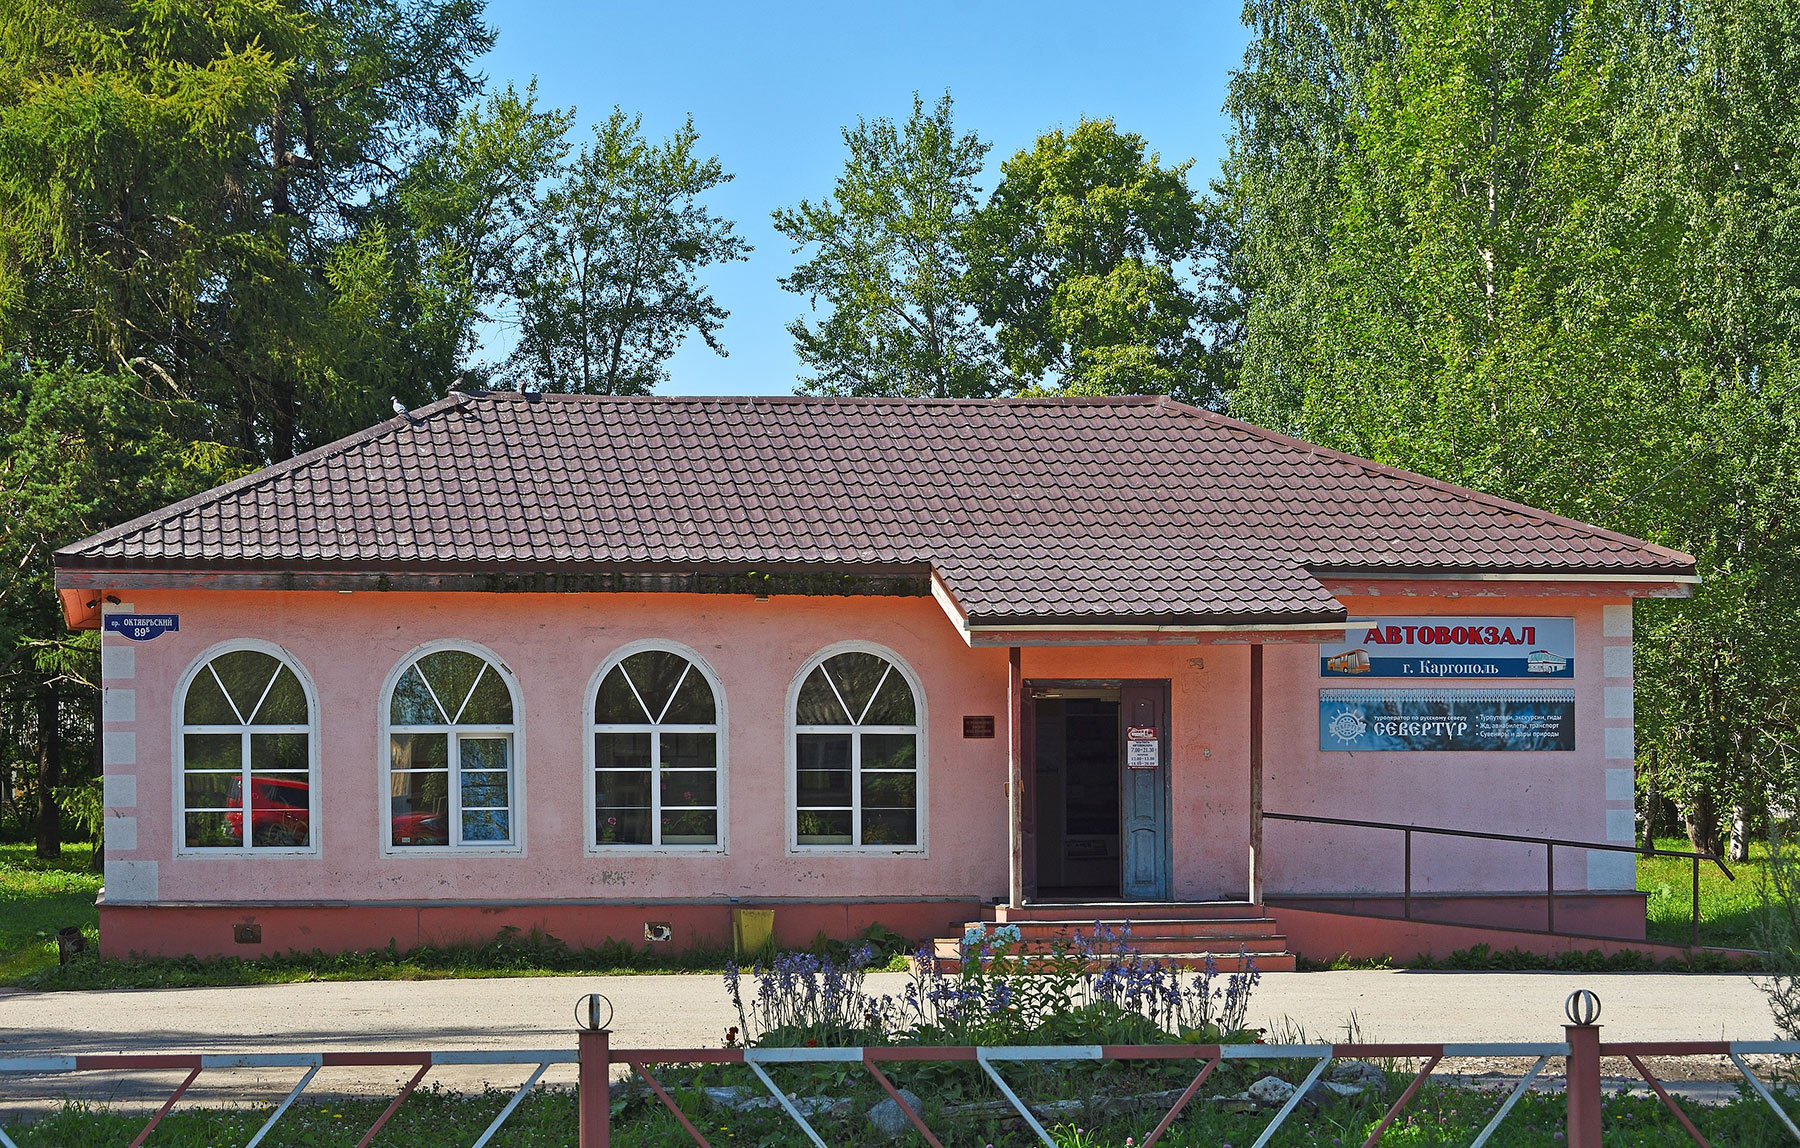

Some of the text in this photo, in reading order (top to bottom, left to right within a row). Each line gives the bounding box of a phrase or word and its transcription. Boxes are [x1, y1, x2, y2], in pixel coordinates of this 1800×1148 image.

[123, 617, 173, 627] ОКТЯБРЬСКИЙ
[1363, 625, 1536, 646] АВТОВОКЗАЛ
[1402, 659, 1499, 677] г. Каргополь
[1373, 721, 1468, 740] СЕВЕРТУР
